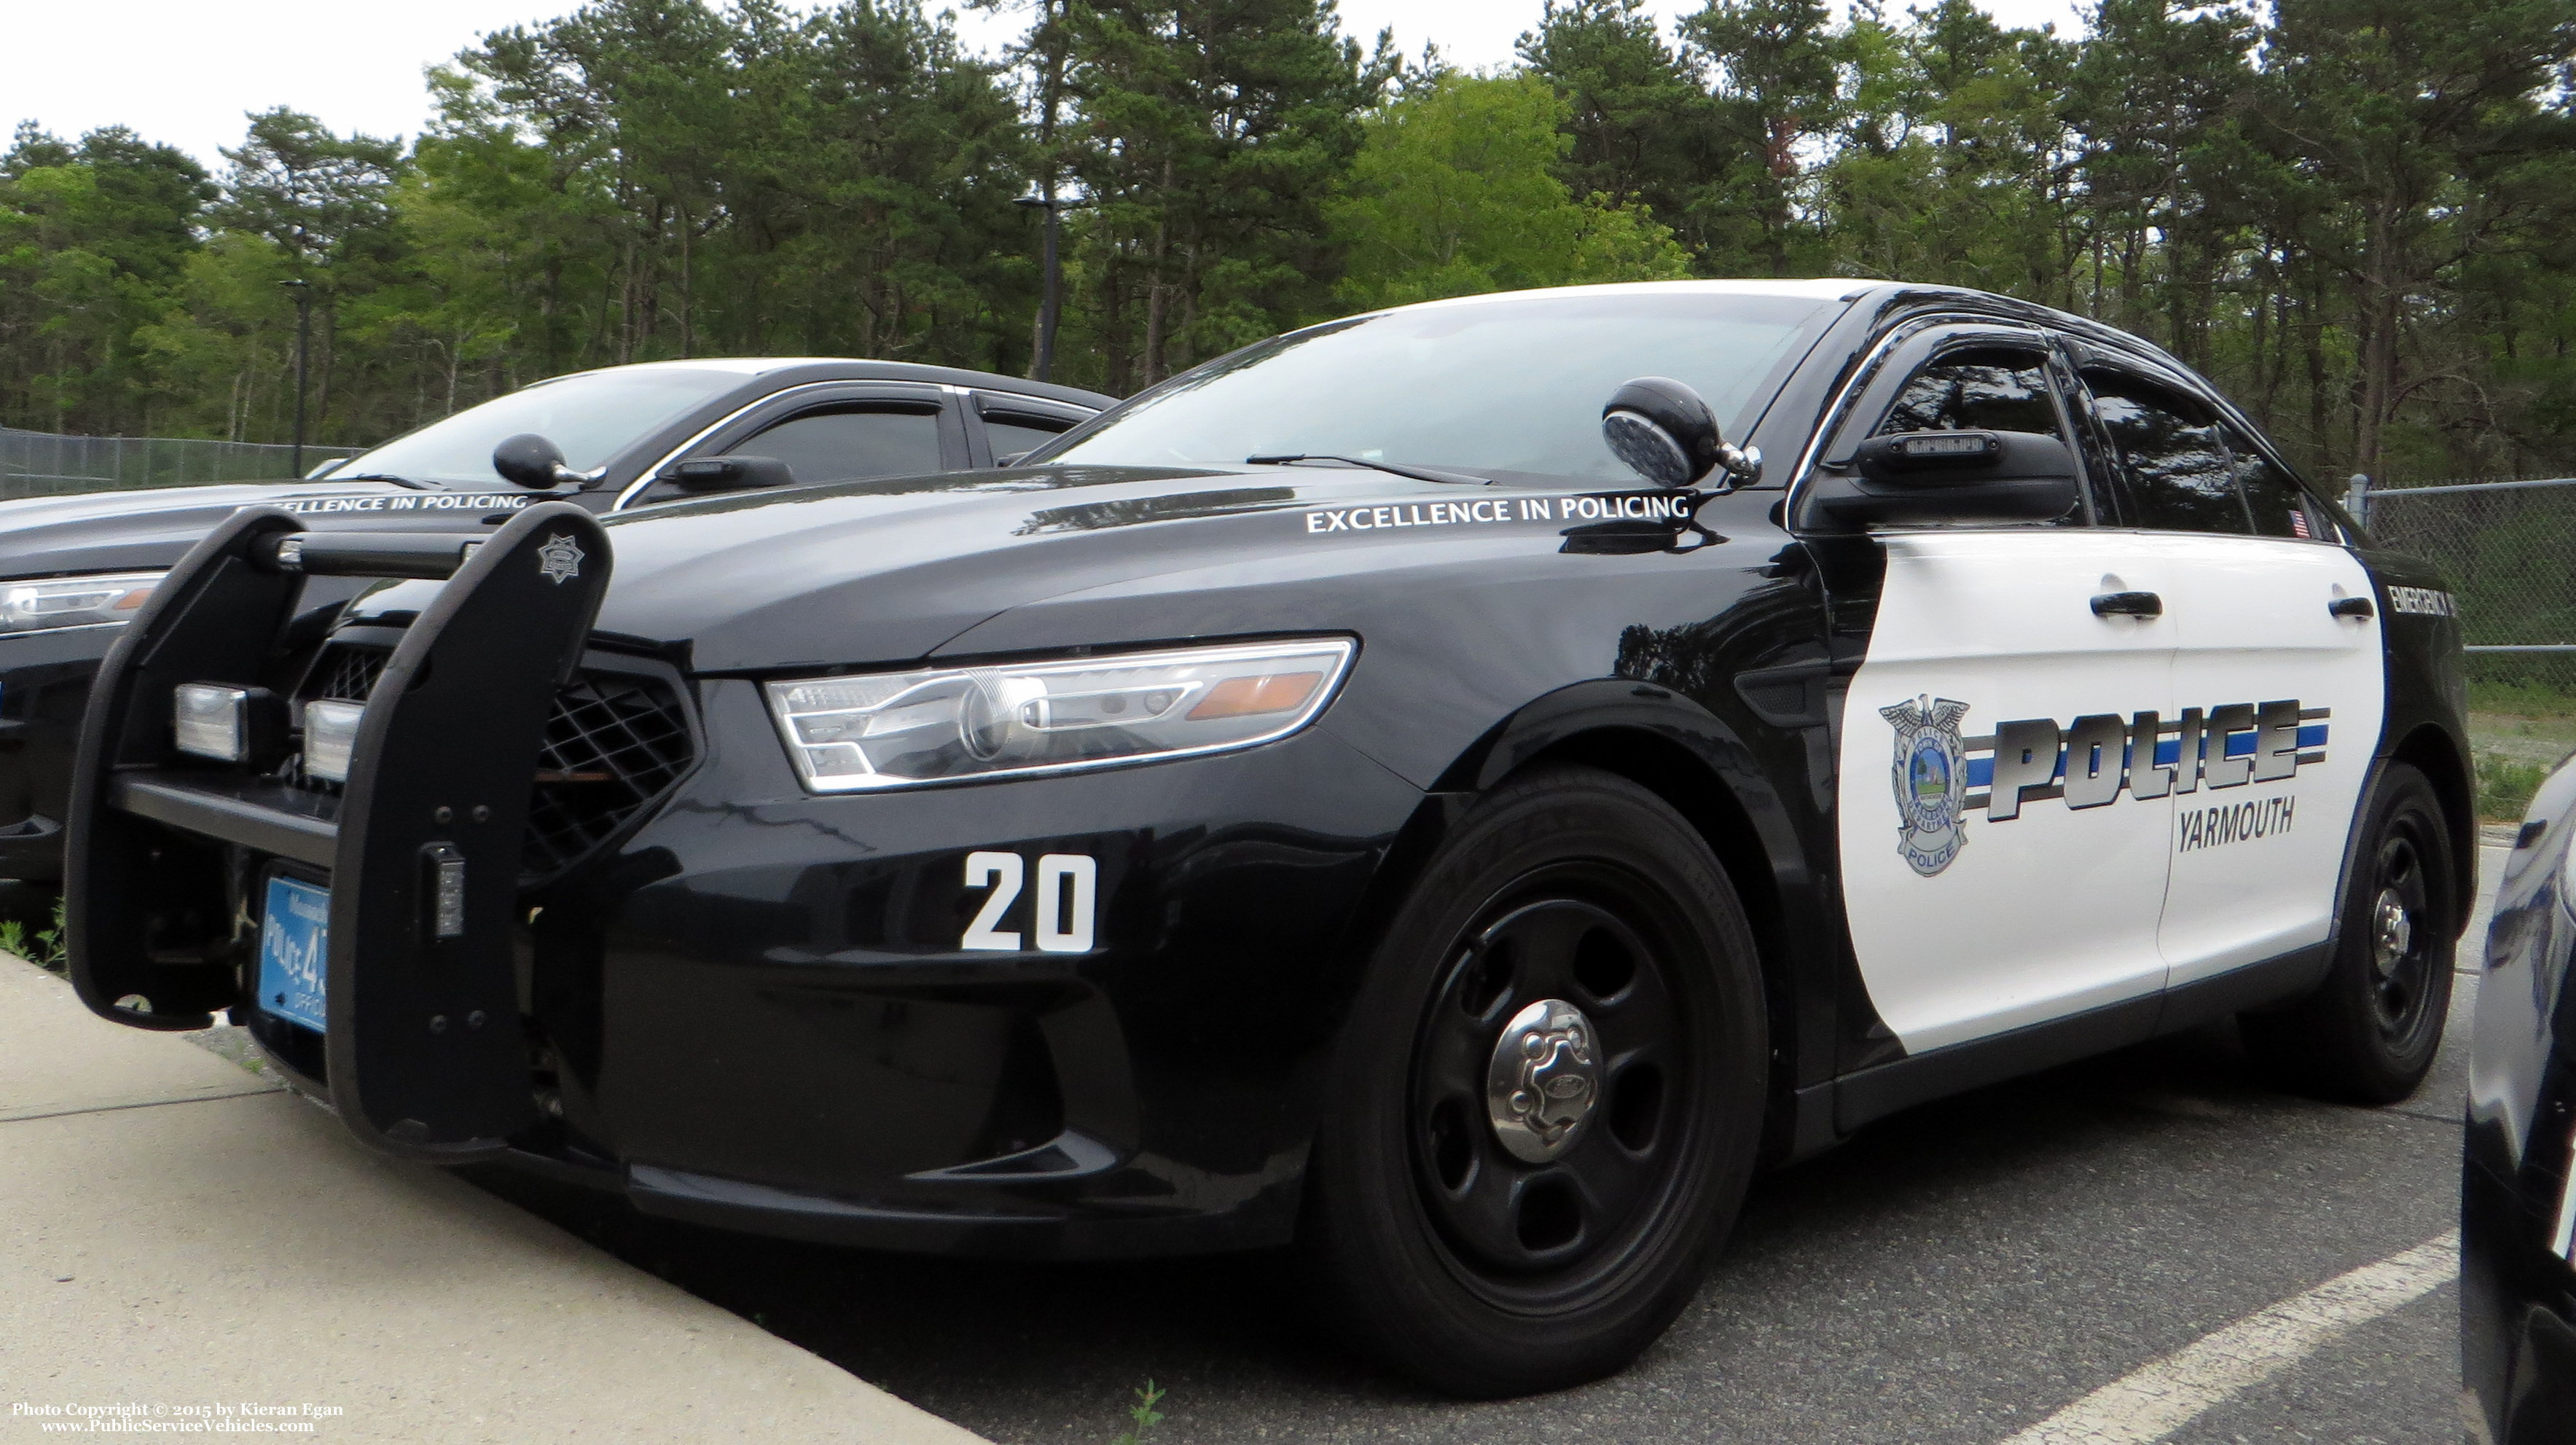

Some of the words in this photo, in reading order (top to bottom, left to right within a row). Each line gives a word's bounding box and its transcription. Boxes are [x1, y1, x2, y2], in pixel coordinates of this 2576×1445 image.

[391, 497, 418, 509] IN
[422, 496, 528, 509] POLICING
[1307, 501, 1510, 533] EXCELLENCE
[1521, 498, 1551, 520] IN
[1562, 496, 1689, 518] POLICING
[2387, 585, 2447, 616] EMERGENCY
[1912, 728, 1945, 745] POLICE
[1988, 700, 2301, 823] POLICE
[2180, 795, 2295, 853] YARMOUTH
[1908, 845, 1957, 867] POLICE
[961, 851, 1097, 952] 20
